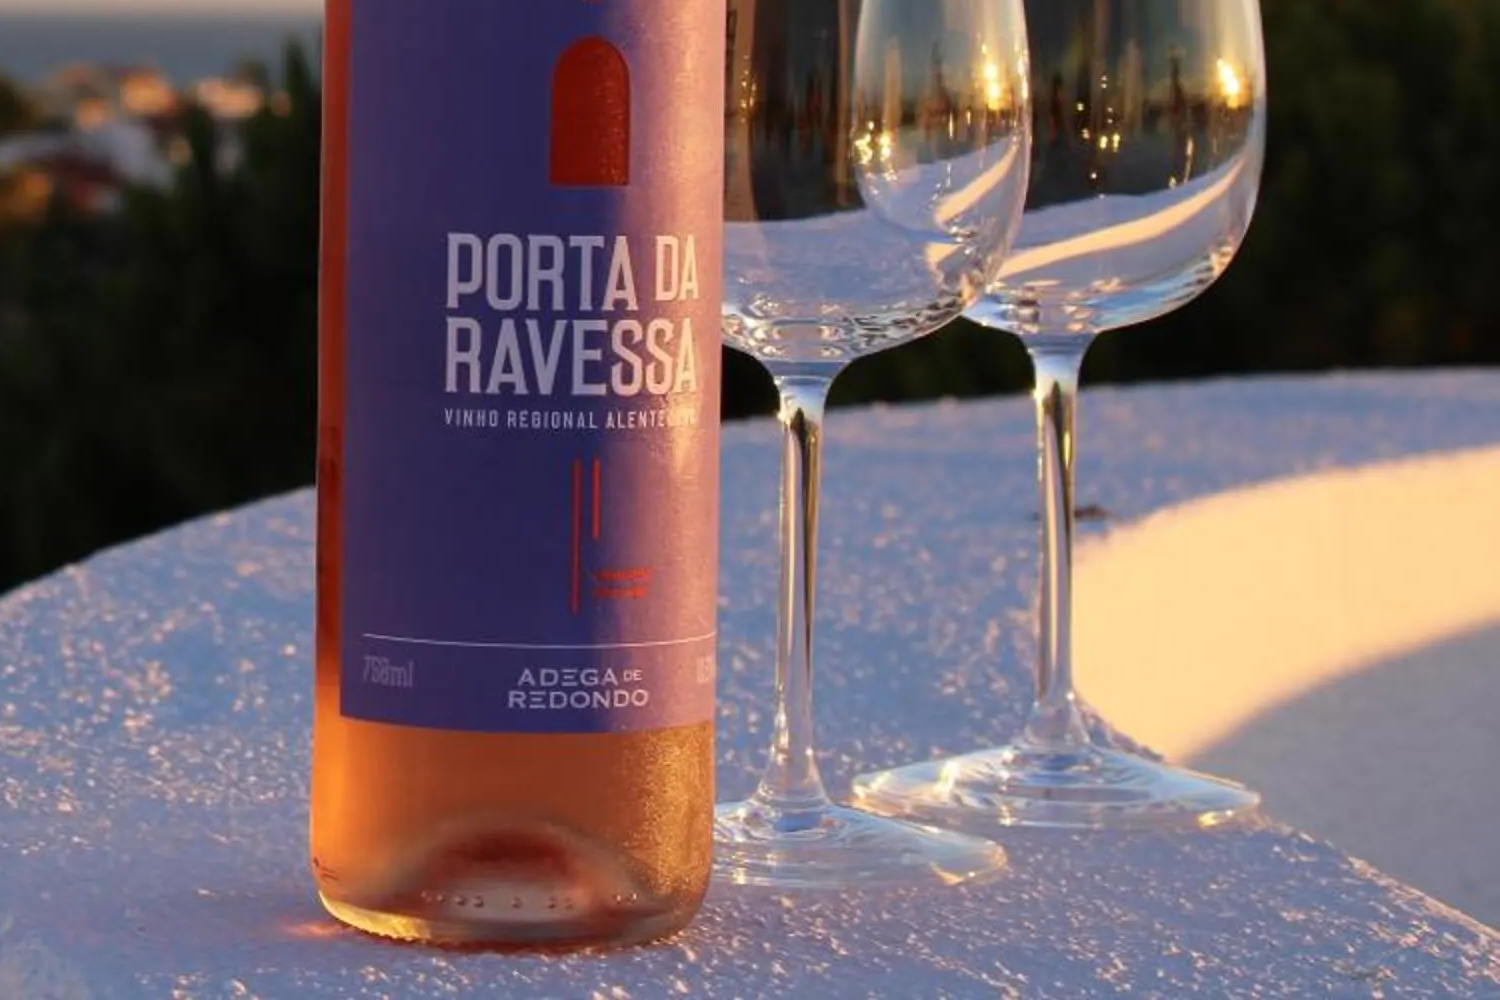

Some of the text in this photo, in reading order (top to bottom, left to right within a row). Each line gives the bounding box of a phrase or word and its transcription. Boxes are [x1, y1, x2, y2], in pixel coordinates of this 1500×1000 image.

[445, 233, 700, 311] PORTA DA
[444, 315, 698, 396] RAVESSA
[444, 407, 697, 430] VINHO REGIONAL ALENTE
[517, 667, 643, 687] ADEGA DE
[507, 688, 649, 709] REDONDO
